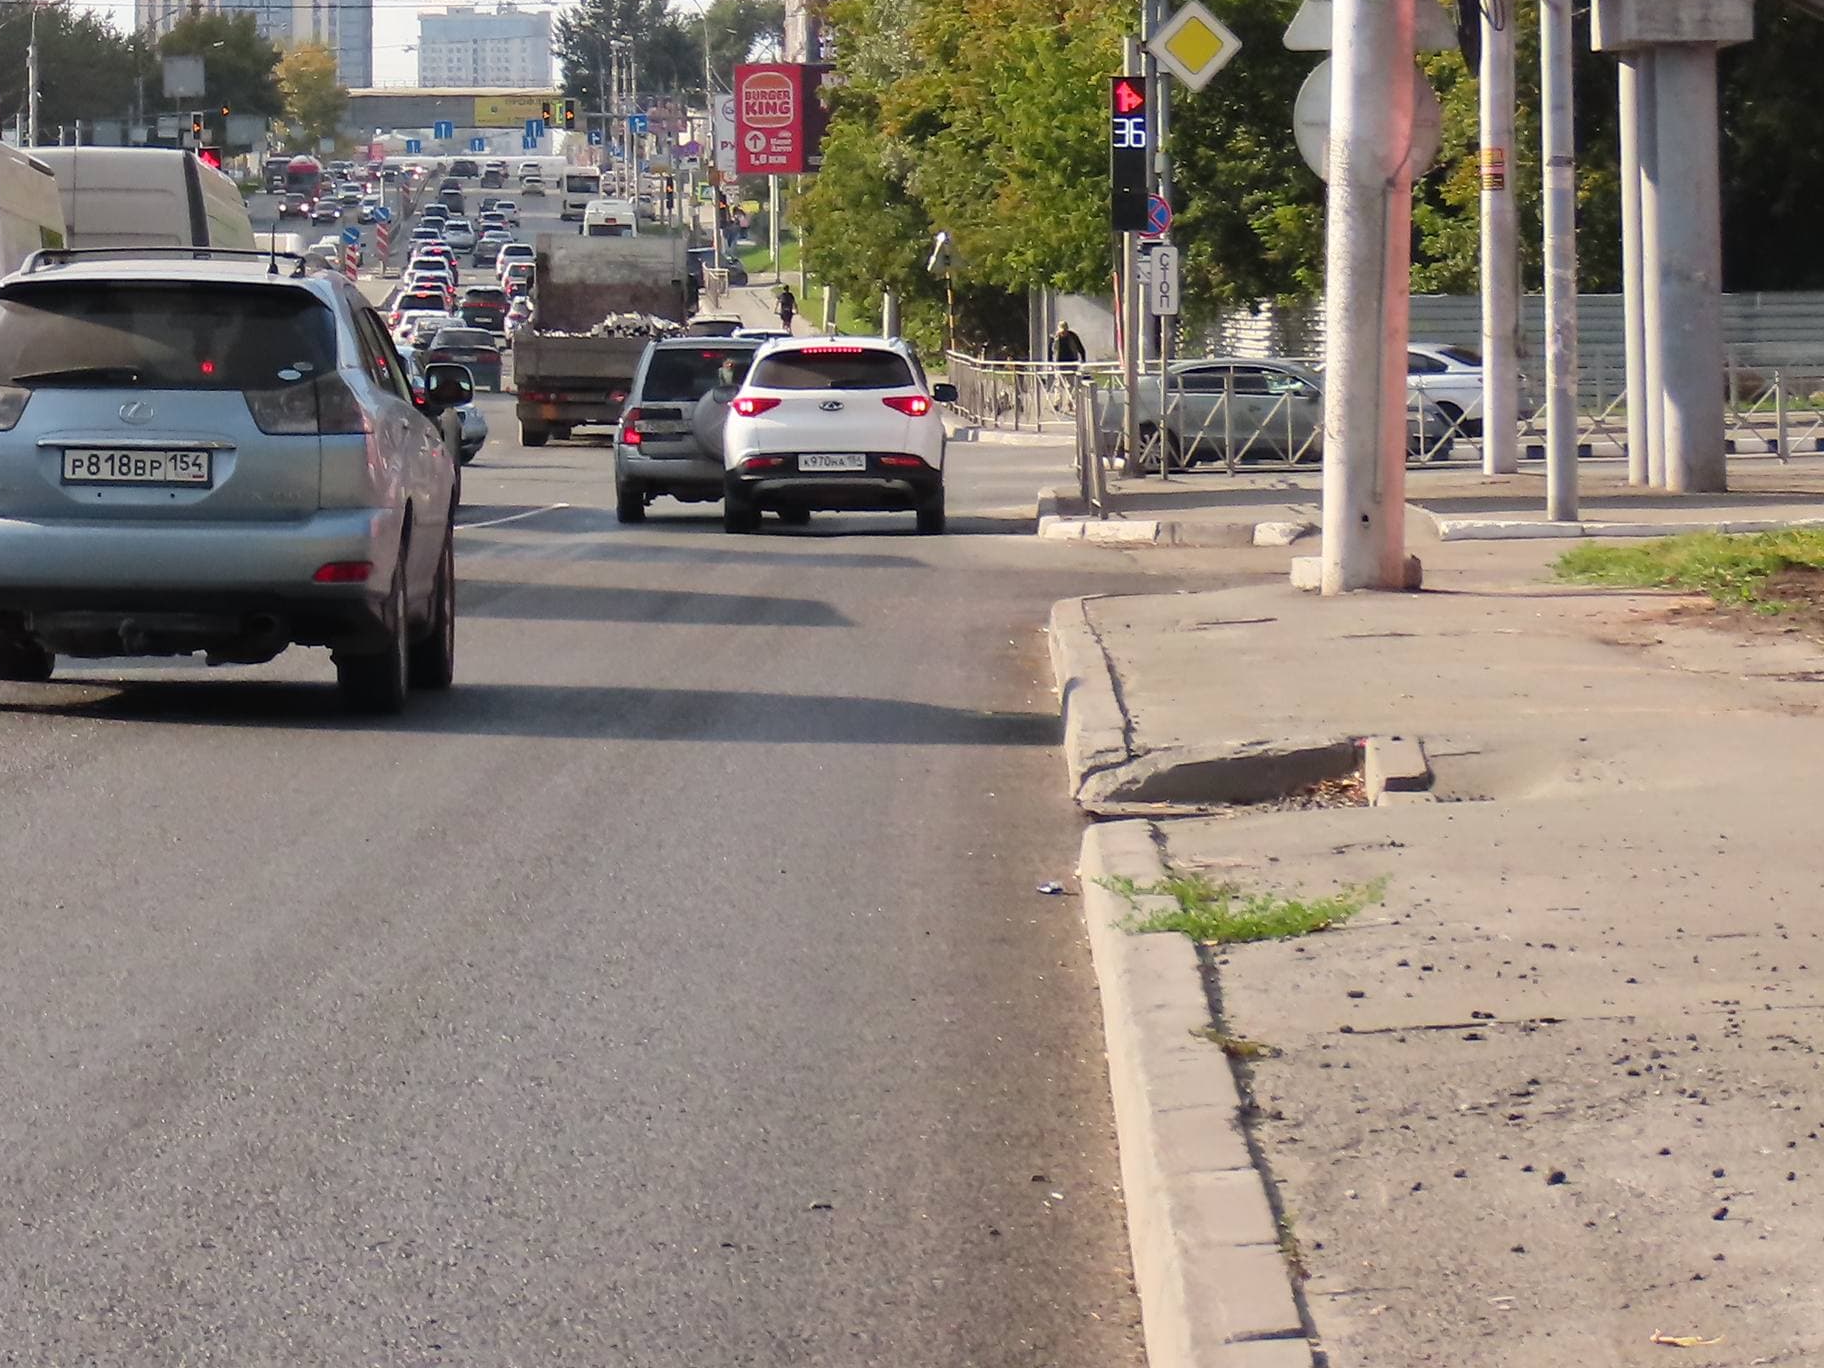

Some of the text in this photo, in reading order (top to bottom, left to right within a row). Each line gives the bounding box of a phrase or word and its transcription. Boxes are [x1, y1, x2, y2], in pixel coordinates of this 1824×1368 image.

[744, 90, 791, 101] BURGER
[745, 101, 791, 115] KING
[1113, 118, 1146, 148] 36
[72, 453, 203, 476] Р818ВР 154
